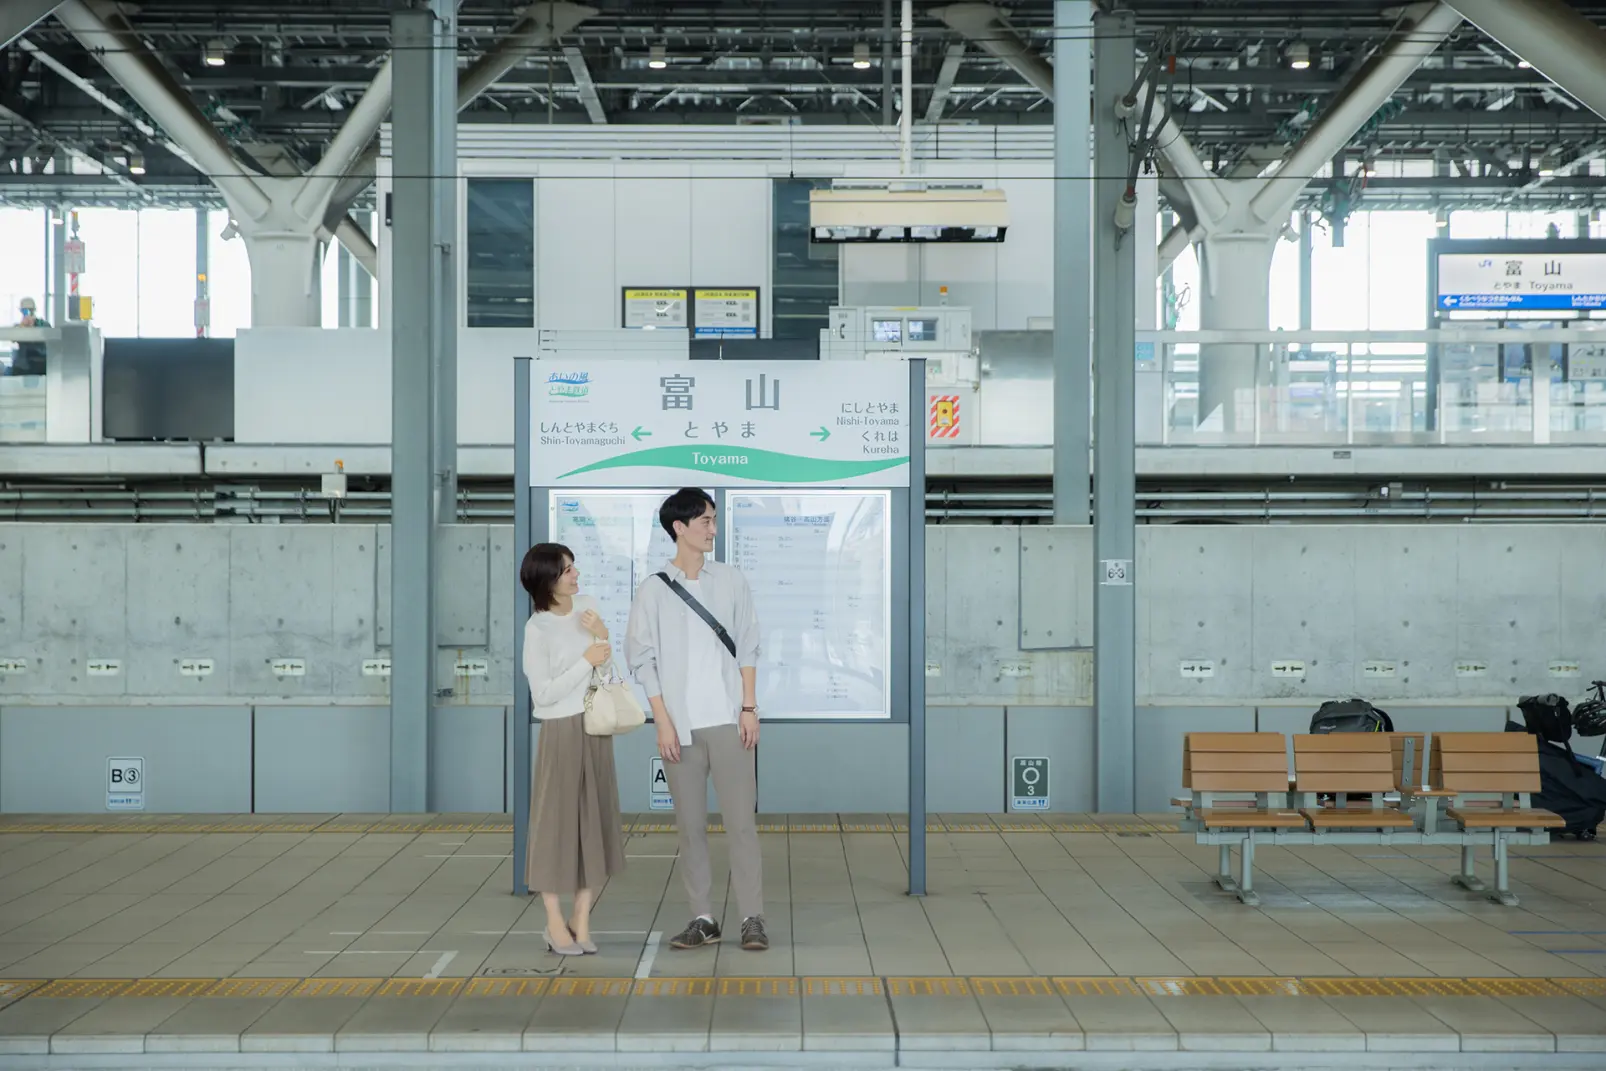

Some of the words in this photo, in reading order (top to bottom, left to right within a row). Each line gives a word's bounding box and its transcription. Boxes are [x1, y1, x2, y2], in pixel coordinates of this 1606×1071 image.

[1505, 259, 1562, 277] 富山
[1529, 281, 1574, 292] Toyama
[660, 374, 780, 411] 富山
[841, 402, 900, 414] にしとやま
[540, 421, 619, 433] しんとやまぐち
[836, 416, 900, 427] Nishi-Toyama
[684, 421, 756, 439] とやま
[860, 430, 899, 442] くれは
[540, 435, 626, 447] Shin-Toyamaguchi
[863, 445, 899, 455] Kureha
[692, 452, 749, 466] Toyama
[1027, 785, 1035, 796] 3
